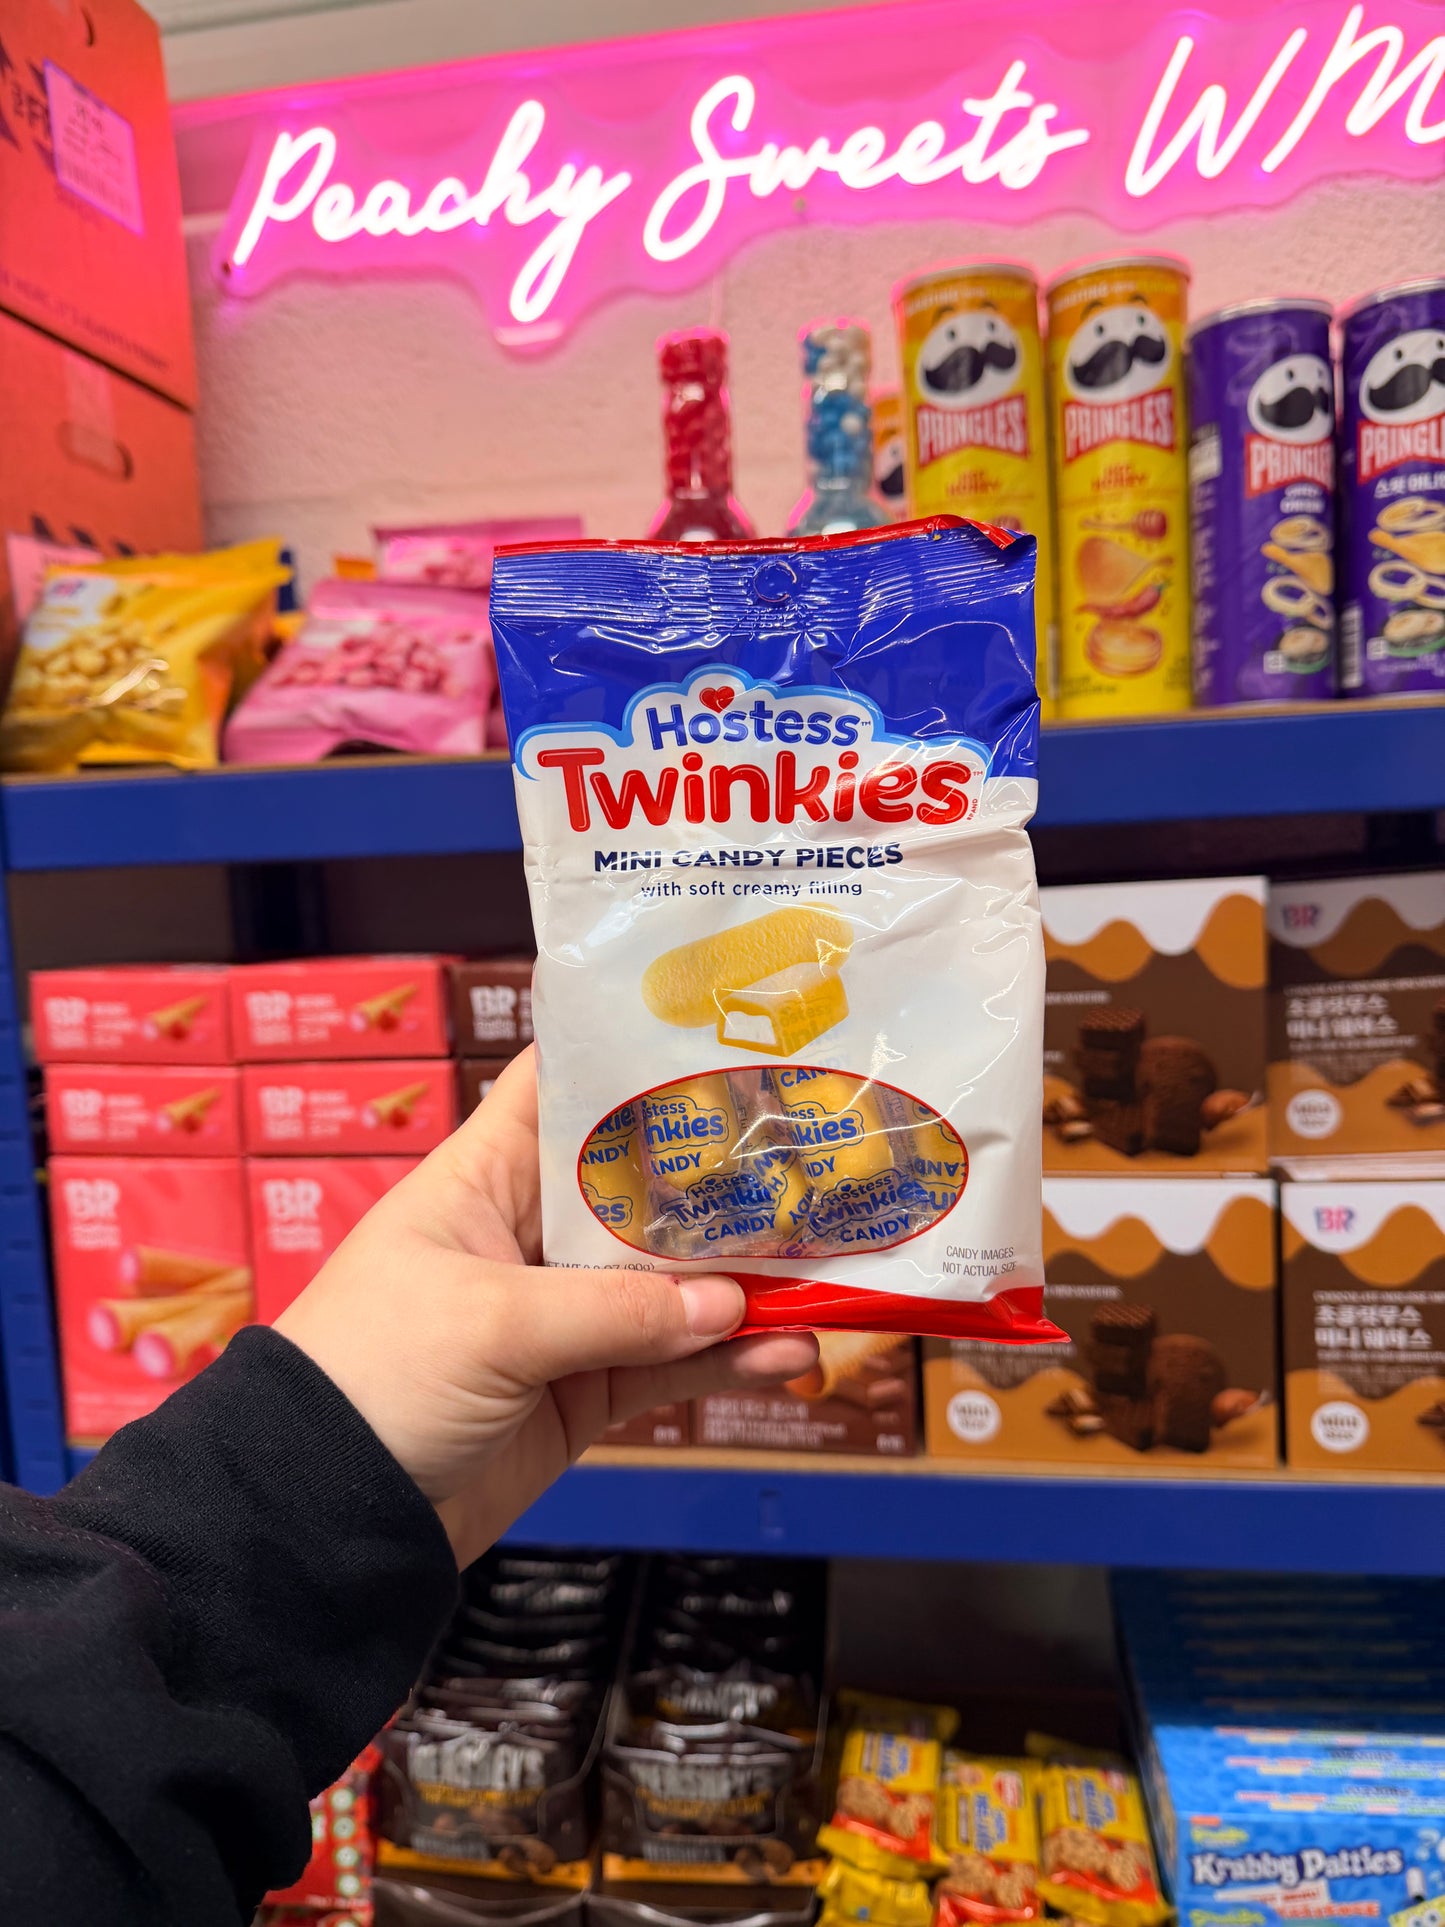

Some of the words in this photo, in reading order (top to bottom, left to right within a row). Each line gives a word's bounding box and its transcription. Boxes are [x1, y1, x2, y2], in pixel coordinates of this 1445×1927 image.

[234, 100, 631, 322] Peachy
[643, 60, 1090, 262] Sweets
[917, 396, 1026, 465] PRINGLES
[1065, 390, 1173, 462] PRINGLES
[646, 700, 861, 750] Hostess
[537, 749, 972, 832] Twinkies
[594, 850, 661, 872] MINI
[672, 850, 783, 868] CANDY
[796, 842, 904, 868] PIECES
[642, 881, 682, 897] with
[689, 880, 725, 896] soft
[732, 882, 801, 897] creamy
[809, 880, 862, 897] filling
[704, 1213, 776, 1241] CANDY
[840, 1213, 911, 1243] CANDY
[942, 1261, 962, 1274] NOT
[963, 1264, 1000, 1277] ACTUAL
[1000, 1261, 1017, 1274] SIZE
[946, 1245, 979, 1260] CANDY
[981, 1246, 1014, 1260] IMAGES
[1191, 1850, 1300, 1889] Krabby
[1301, 1846, 1404, 1880] Patties
